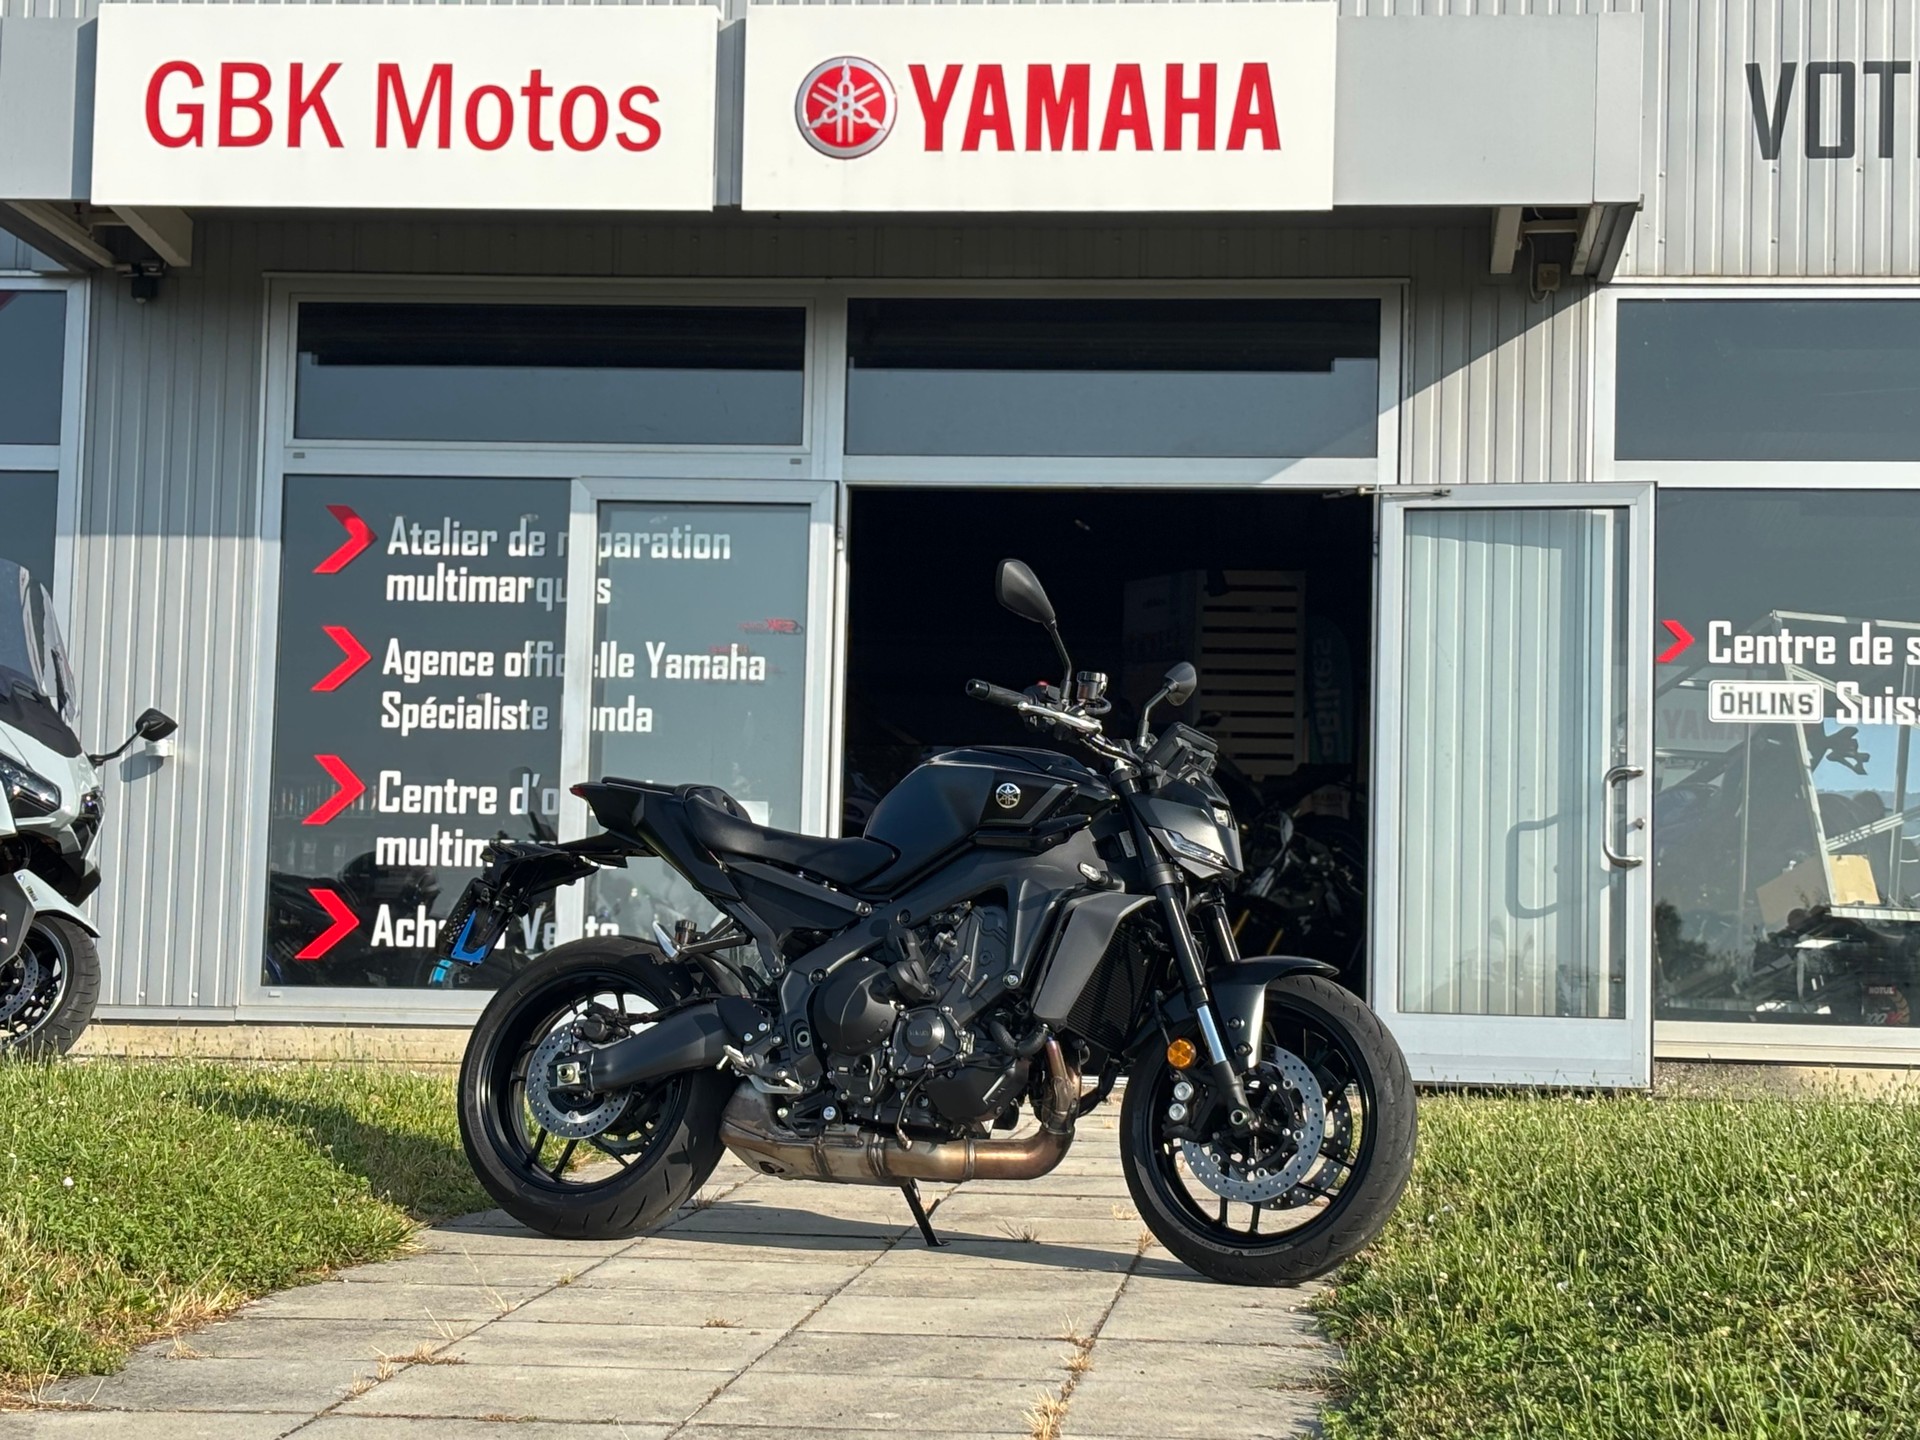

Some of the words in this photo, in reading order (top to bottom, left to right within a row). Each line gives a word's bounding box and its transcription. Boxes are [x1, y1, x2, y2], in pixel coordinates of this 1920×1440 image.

[145, 61, 344, 149] GBK
[375, 63, 662, 152] Motos
[908, 62, 1281, 152] YAMAHA
[1745, 60, 1920, 161] VOT
[387, 516, 498, 556] Atelier
[508, 518, 546, 557] de
[557, 525, 731, 566] rparation
[386, 562, 612, 612] multimarqus
[382, 638, 494, 683] Agence
[645, 641, 766, 681] Yamaha
[1708, 620, 1836, 664] Centre
[1849, 622, 1893, 665] de
[381, 691, 548, 736] Spécialiste
[560, 695, 653, 732] nda
[1719, 684, 1815, 715] ÖHLINS
[1836, 681, 1920, 725] Suis
[378, 770, 497, 815] Centre
